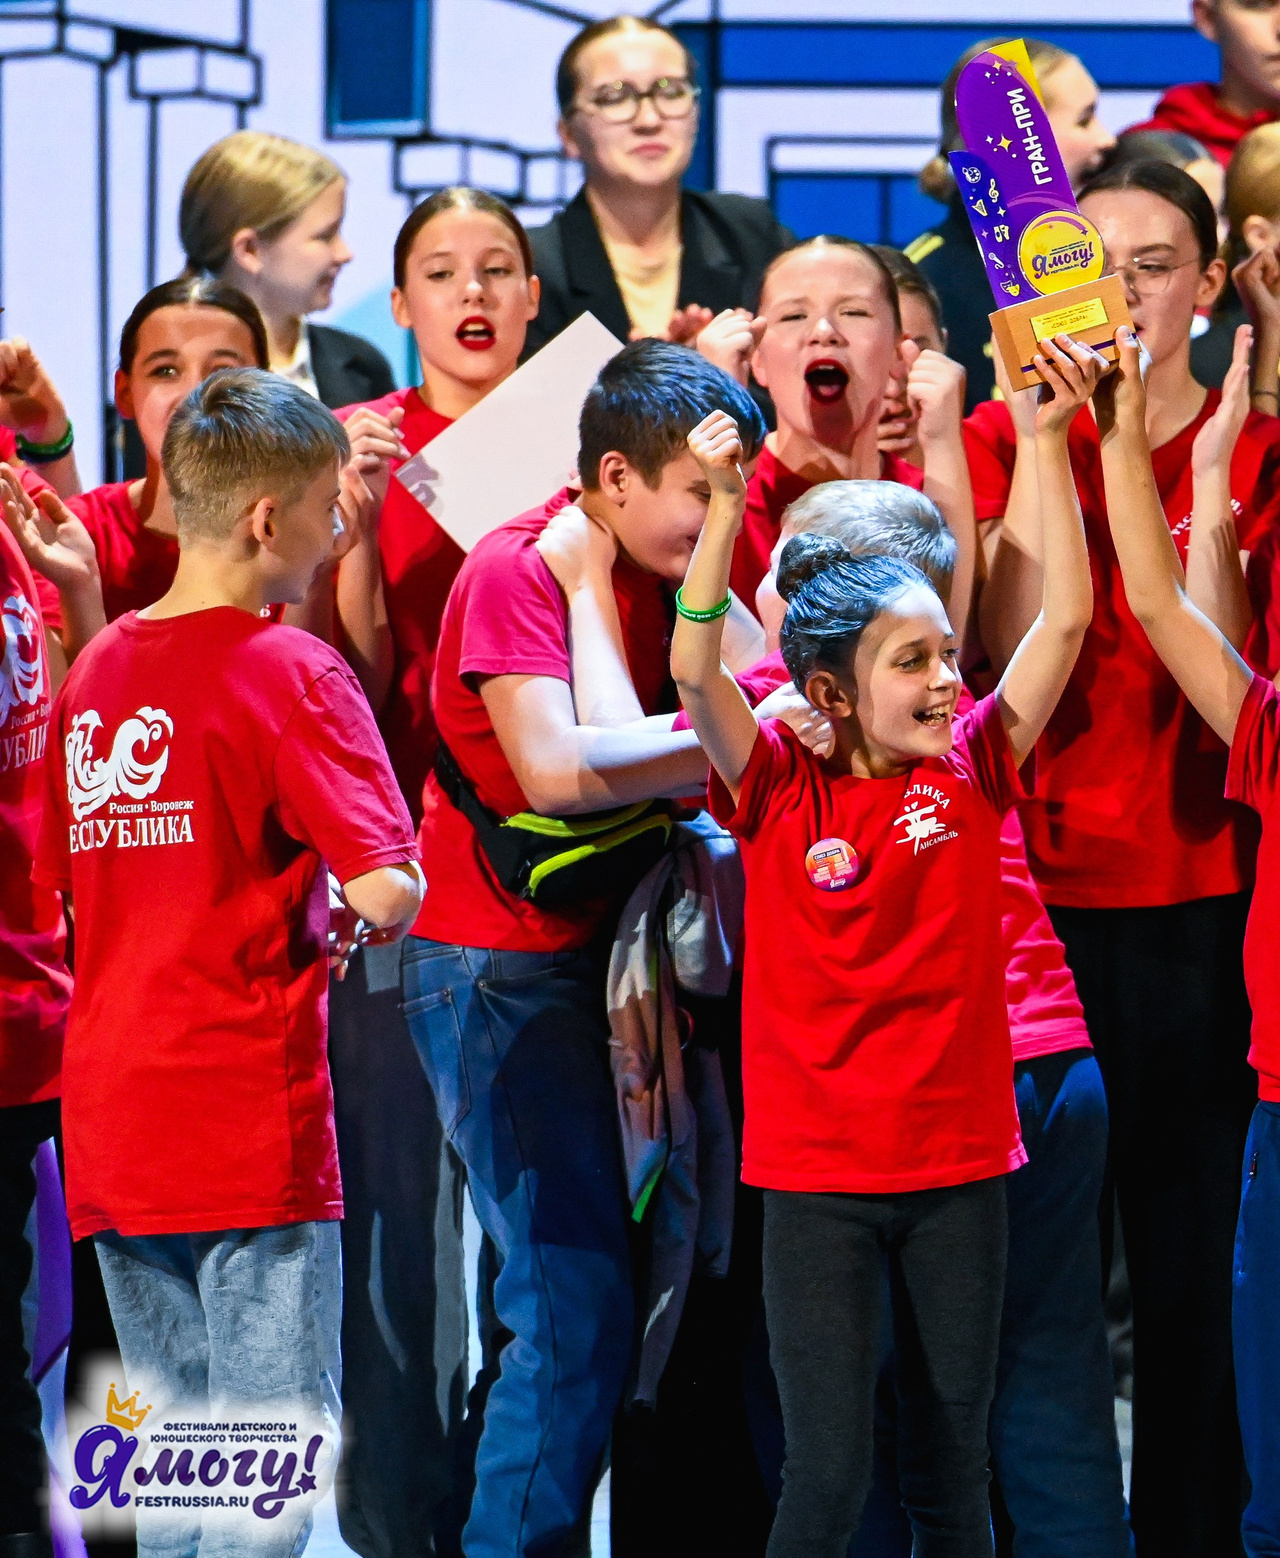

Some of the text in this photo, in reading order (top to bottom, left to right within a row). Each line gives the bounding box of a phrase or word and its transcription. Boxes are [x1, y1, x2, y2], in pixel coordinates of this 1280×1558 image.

[1006, 87, 1053, 186] ГРАН-ПРИ
[109, 800, 195, 815] Россия Воронеж
[919, 830, 959, 851] АНСАМБЛЬ
